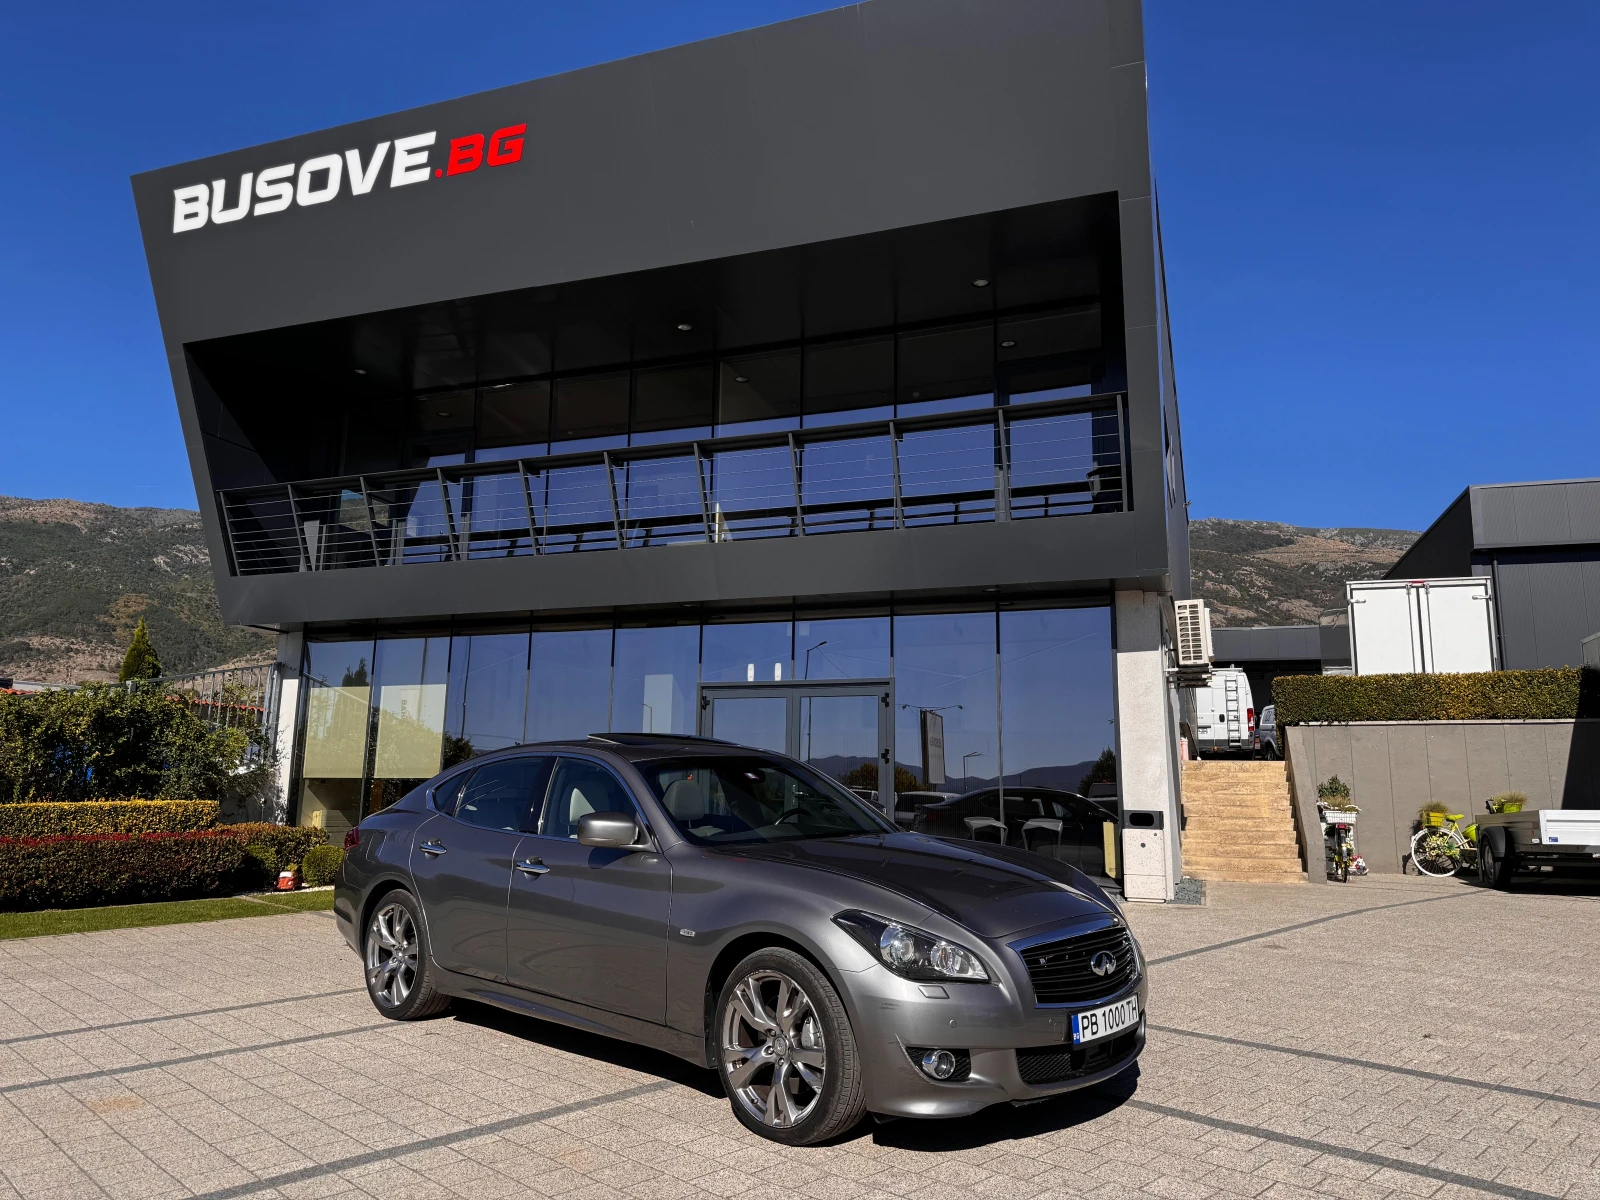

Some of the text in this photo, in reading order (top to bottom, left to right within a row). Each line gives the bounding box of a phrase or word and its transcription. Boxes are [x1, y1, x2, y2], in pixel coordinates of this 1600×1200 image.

[173, 123, 527, 233] BUSOVE.BG
[1081, 997, 1138, 1039] PB 1000 TH
